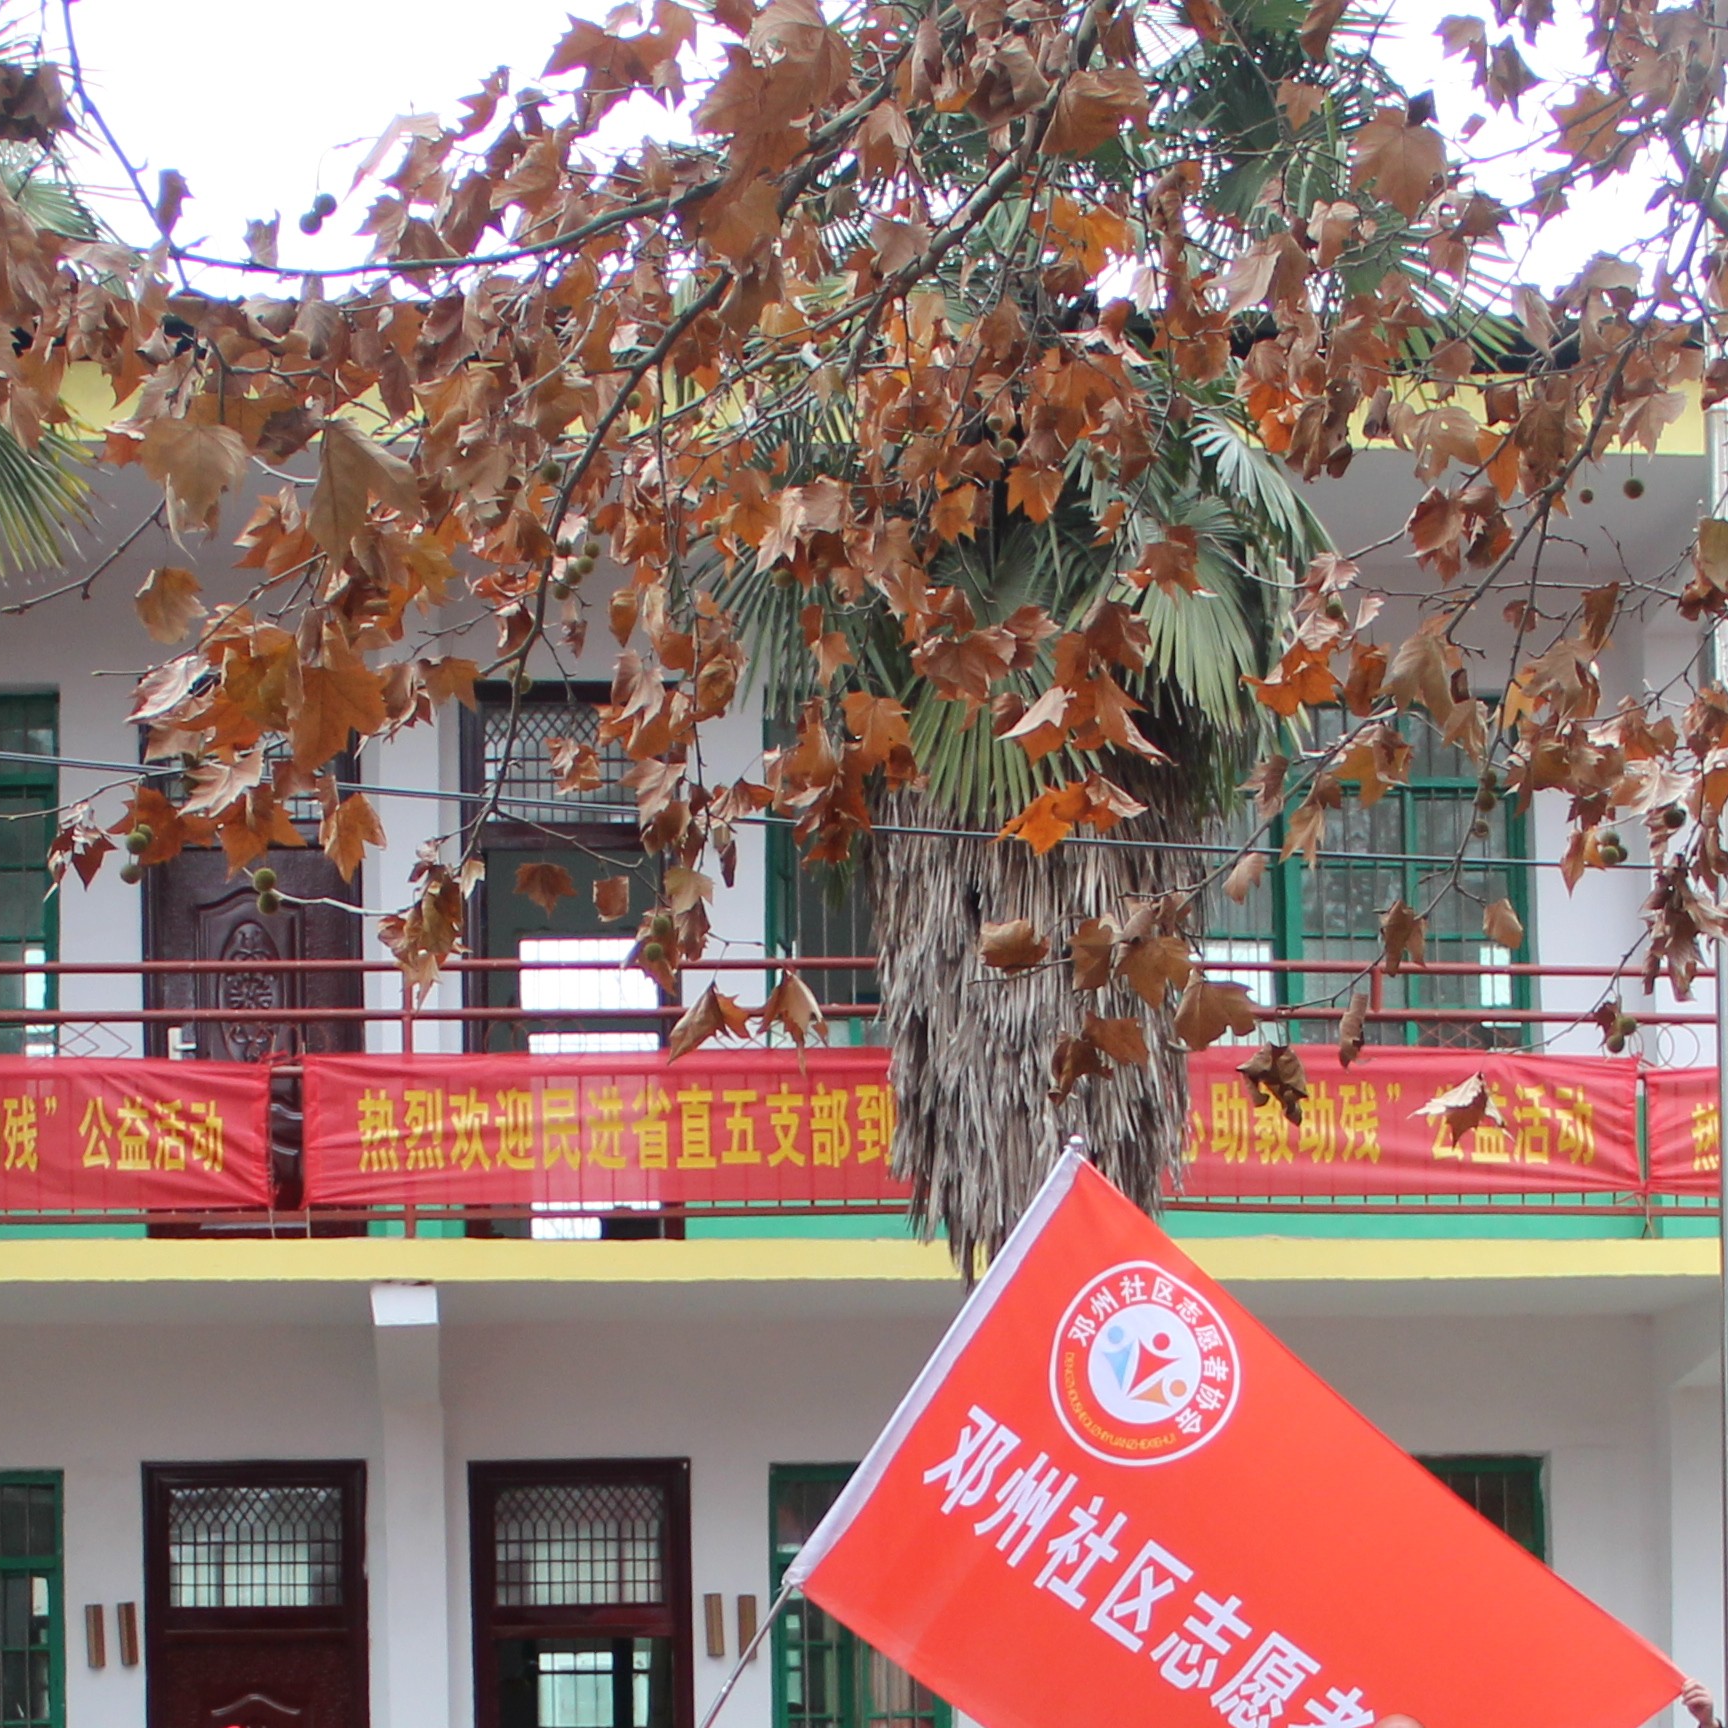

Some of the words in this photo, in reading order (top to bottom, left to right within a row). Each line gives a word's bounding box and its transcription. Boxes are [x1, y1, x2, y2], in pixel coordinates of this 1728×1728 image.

[1067, 1274, 1230, 1435] 邓州社区志愿者协会
